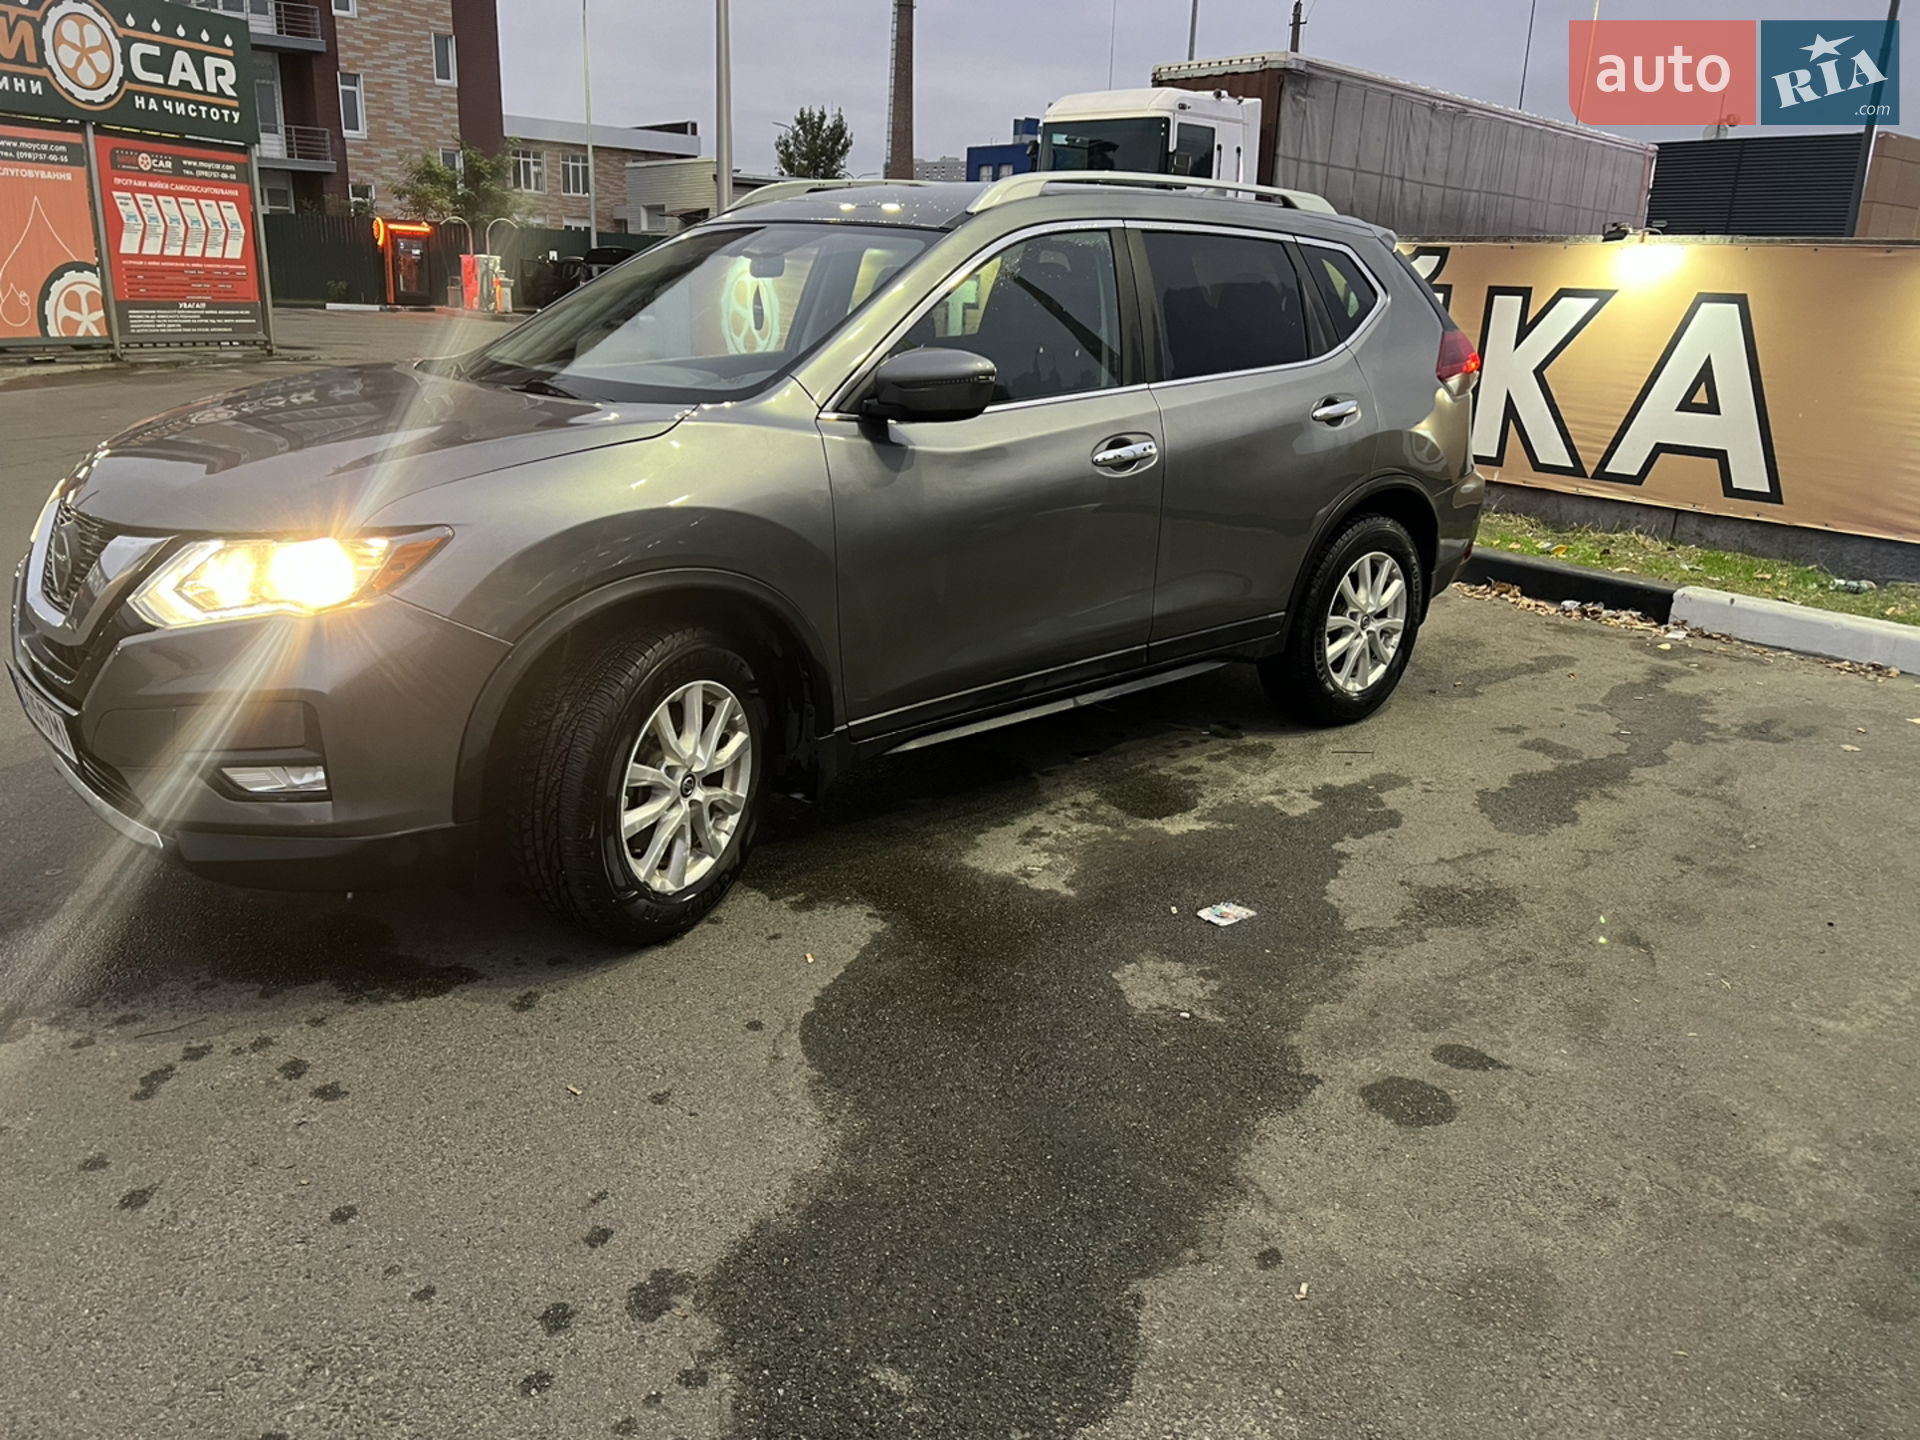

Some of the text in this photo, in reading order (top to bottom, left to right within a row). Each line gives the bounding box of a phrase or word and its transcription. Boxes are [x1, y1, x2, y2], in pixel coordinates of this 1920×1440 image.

[129, 42, 238, 97] CAR
[134, 95, 241, 125] НА ЧИСТОТУ
[151, 158, 172, 169] CAR
[1404, 246, 1785, 505] КА
